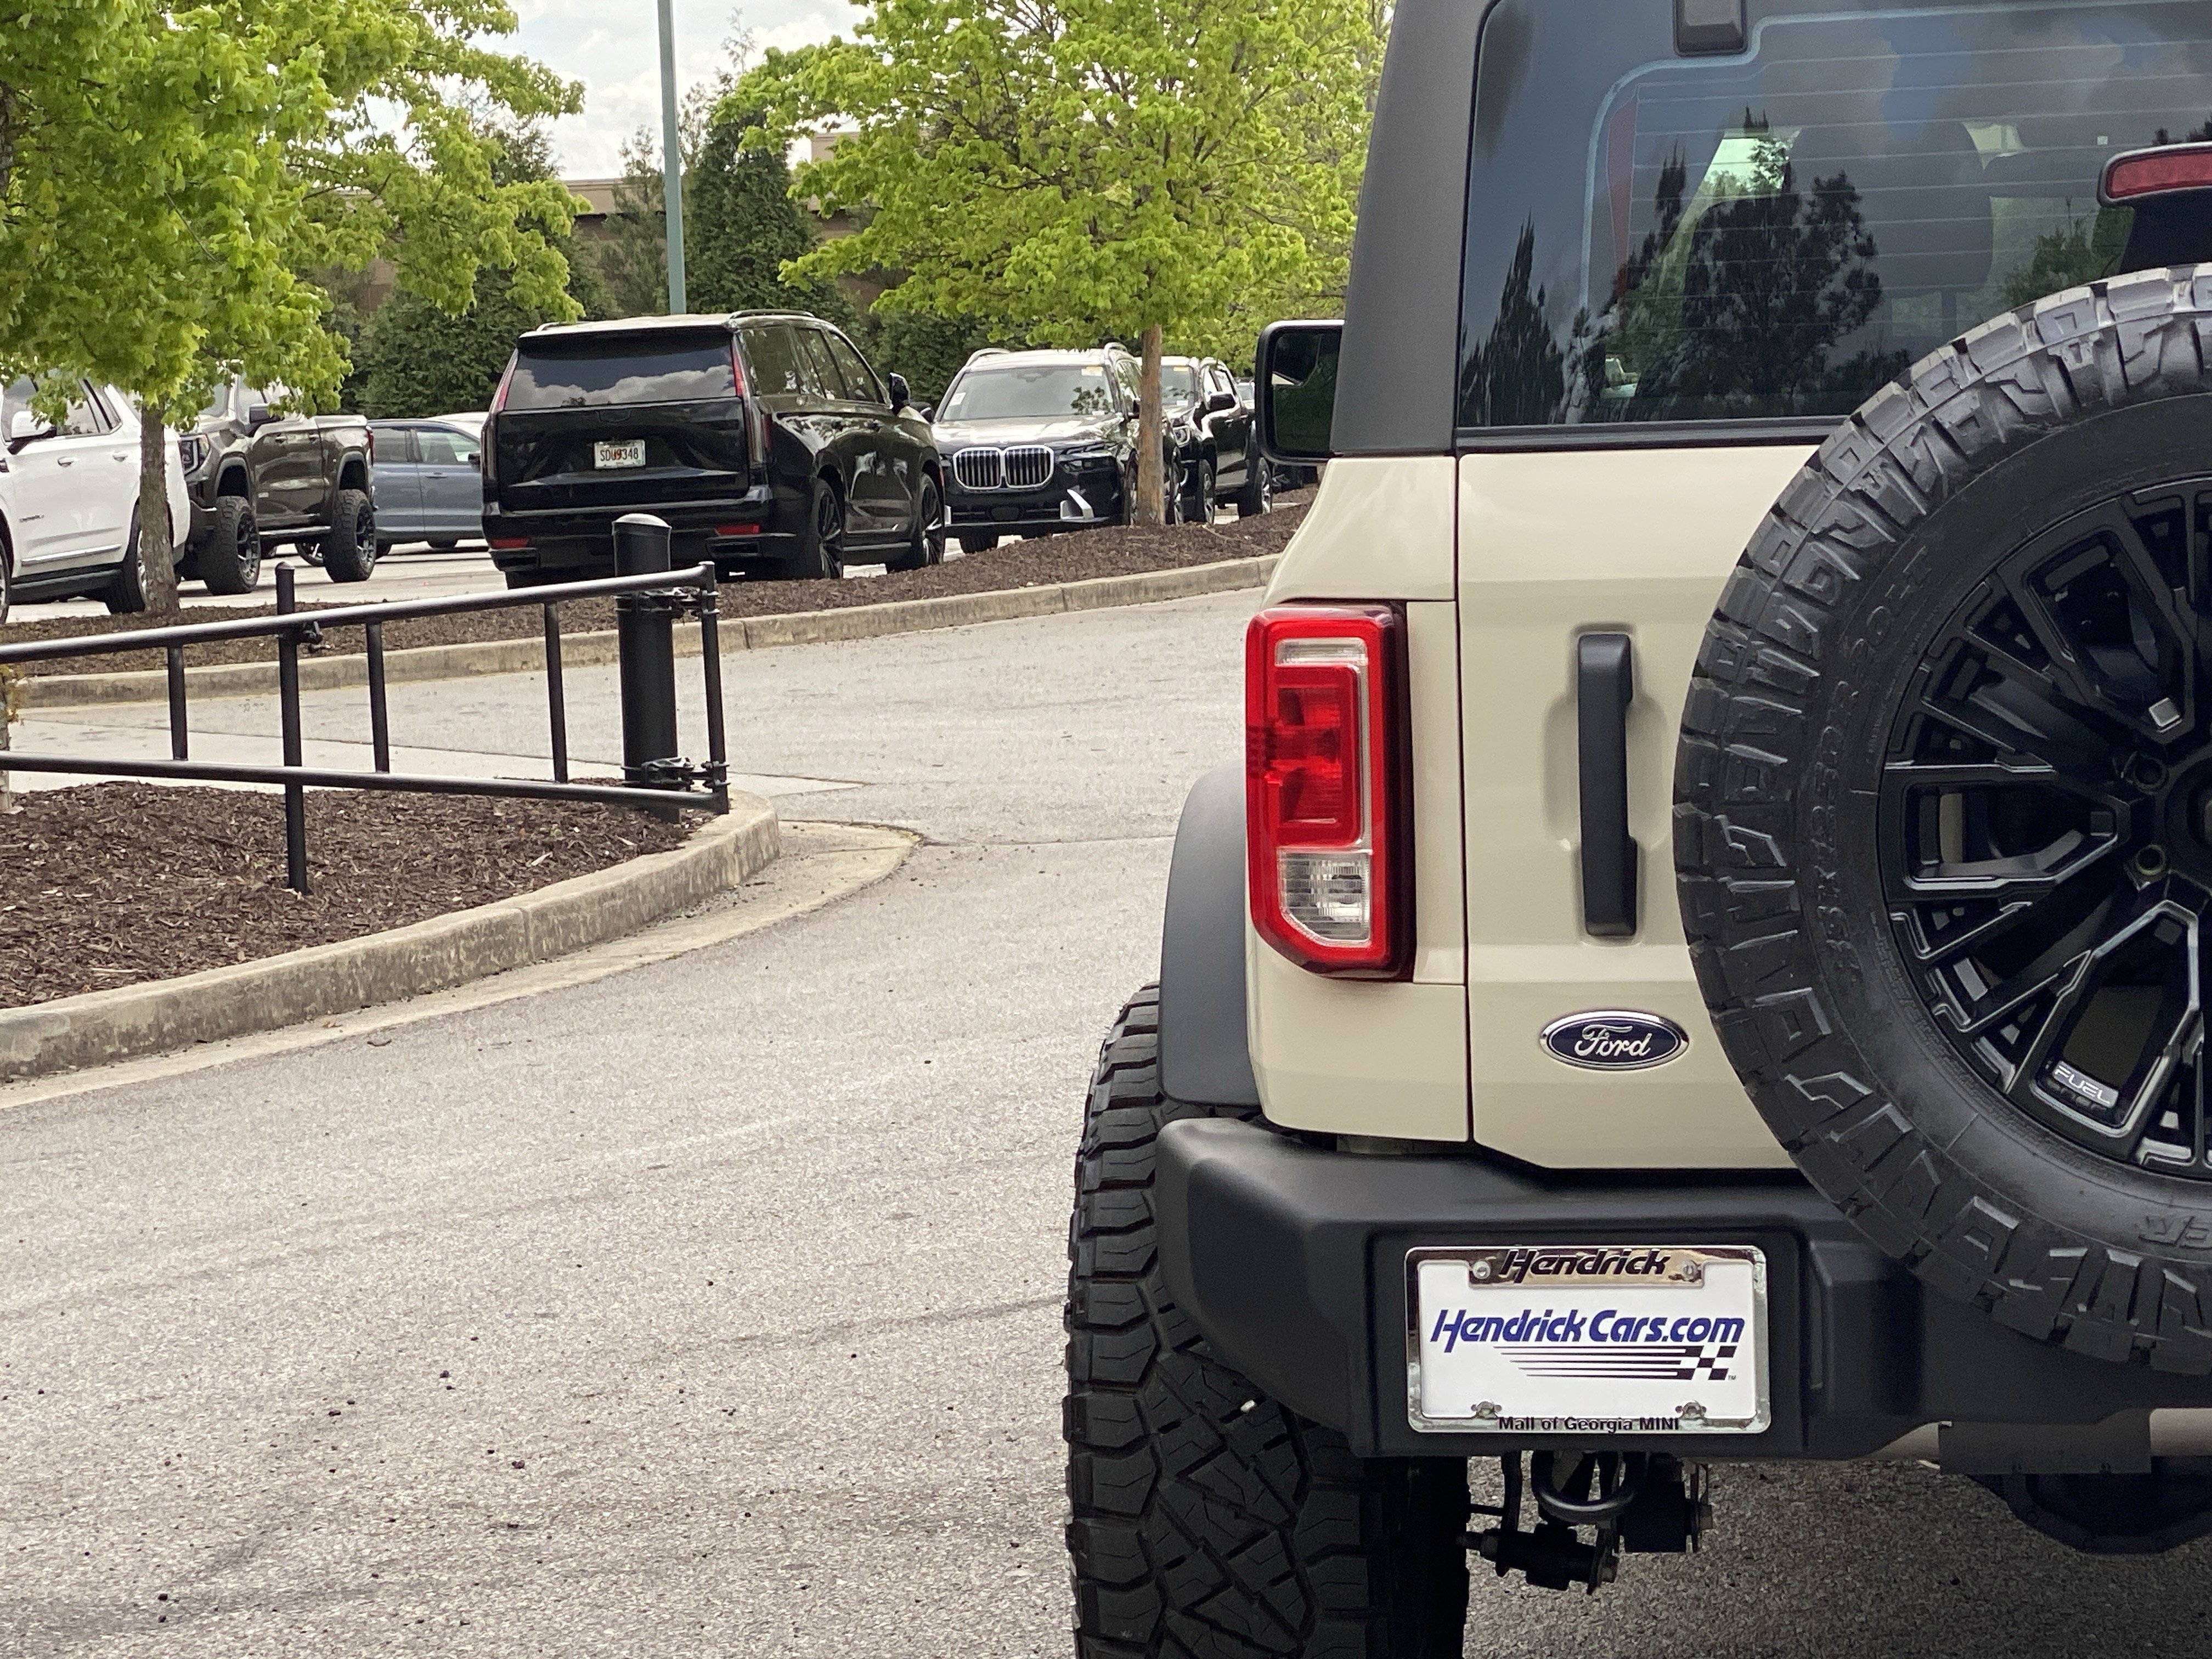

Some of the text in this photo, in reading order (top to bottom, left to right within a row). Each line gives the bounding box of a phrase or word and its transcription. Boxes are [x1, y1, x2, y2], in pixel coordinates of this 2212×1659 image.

[1573, 1024, 1652, 1057] Ford
[2054, 1064, 2112, 1105] FUEL
[1498, 1249, 1671, 1283] Hendrick
[1498, 1417, 1679, 1435] Mall of Georgia MINI
